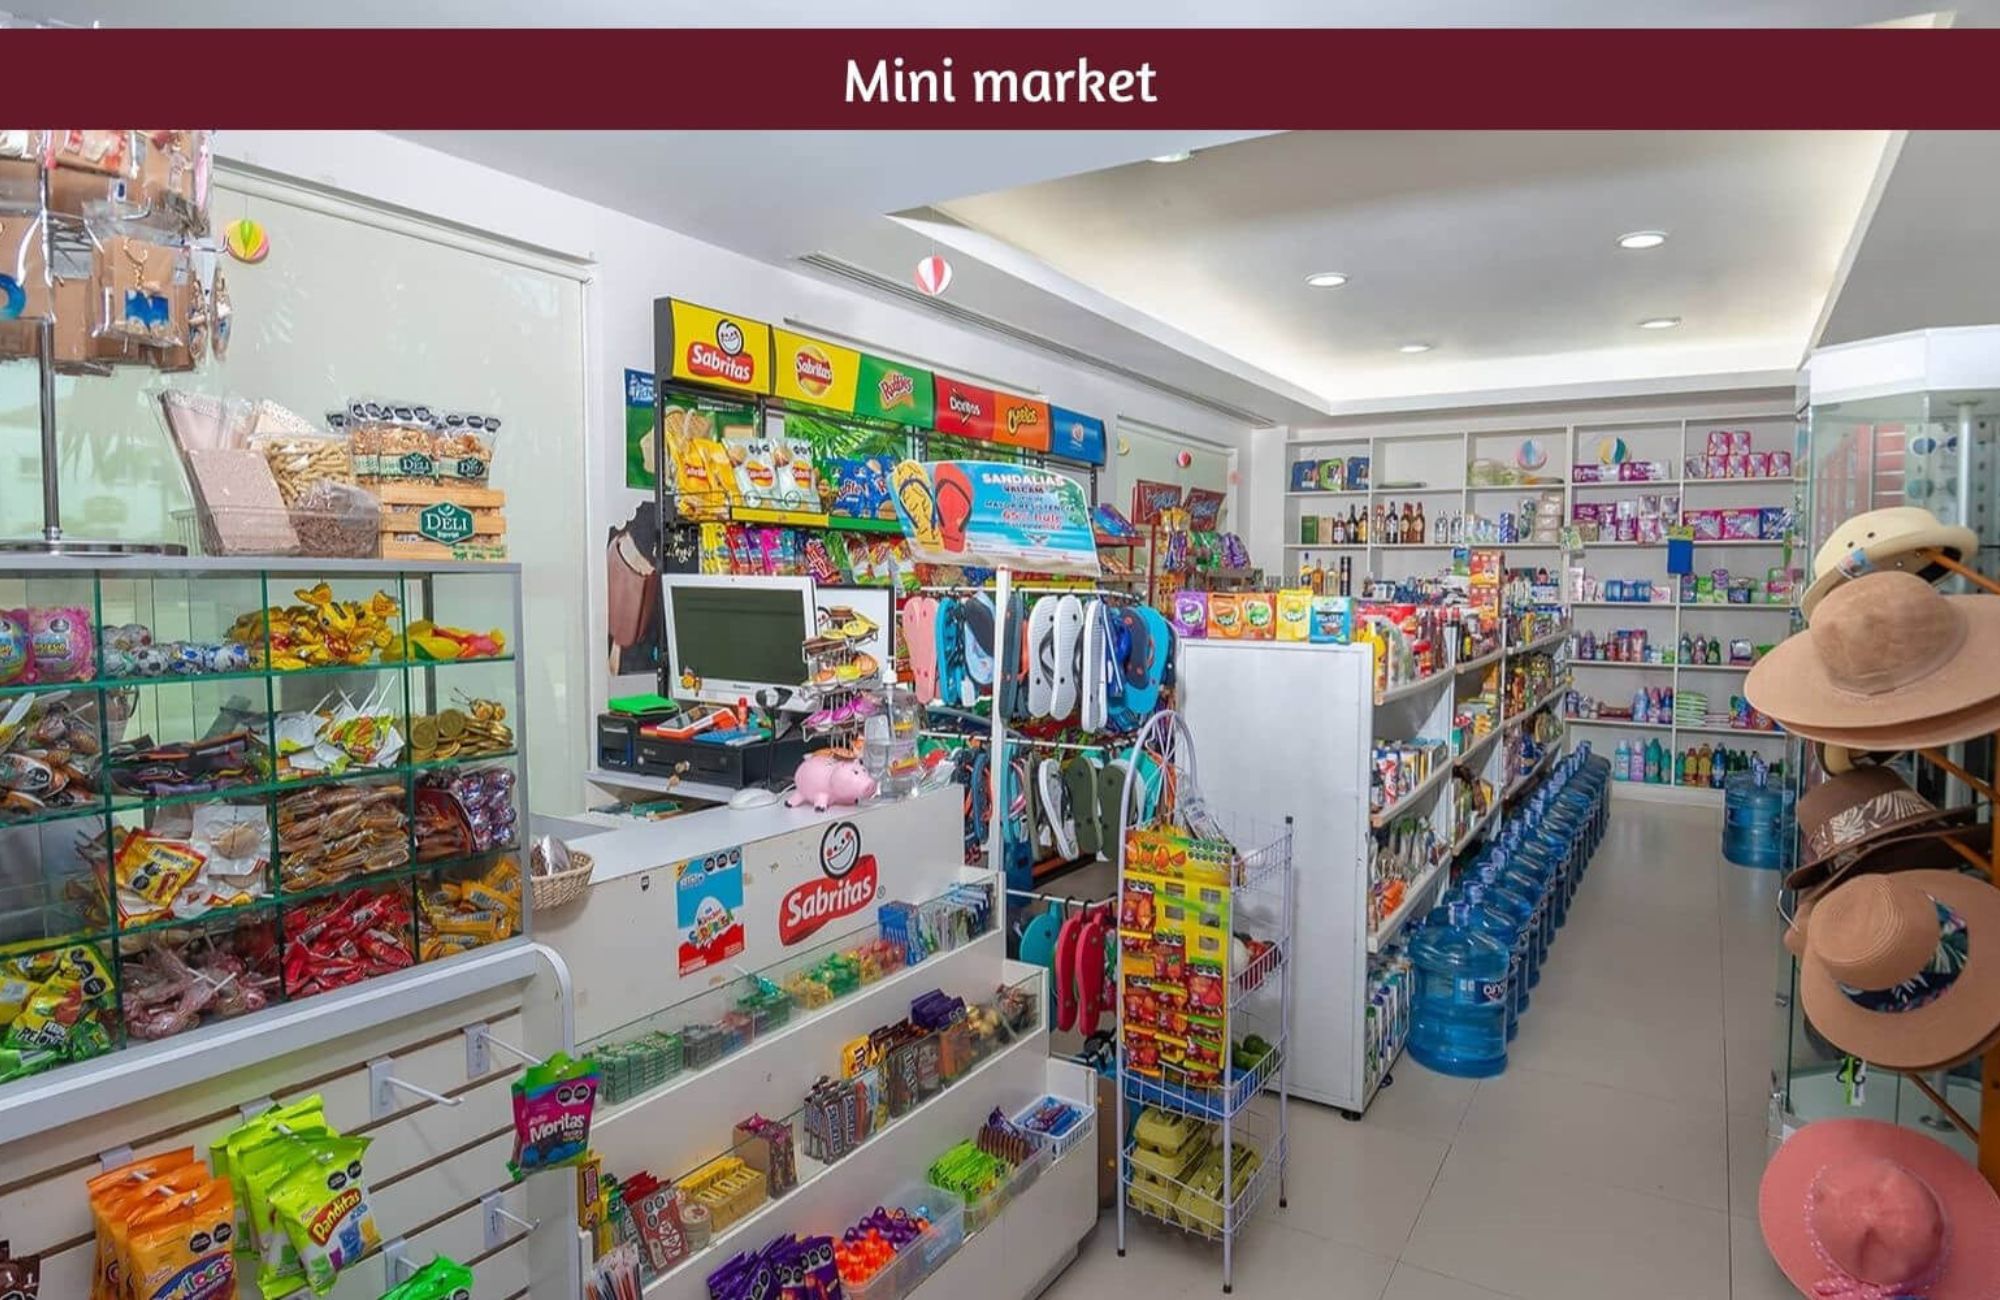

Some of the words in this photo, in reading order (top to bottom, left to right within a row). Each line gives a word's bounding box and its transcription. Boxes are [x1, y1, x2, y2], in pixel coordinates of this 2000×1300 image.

[691, 344, 751, 382] Sabritas
[796, 356, 832, 381] Sabritas
[880, 373, 914, 401] Ruffles
[949, 396, 982, 417] Doritos
[1007, 405, 1039, 435] Cheetos
[981, 473, 1065, 487] SANDALIAS
[425, 512, 468, 531] DELI
[786, 875, 872, 928] Sabritas
[530, 1112, 585, 1143] Moritas
[312, 1191, 361, 1242] Panditas
